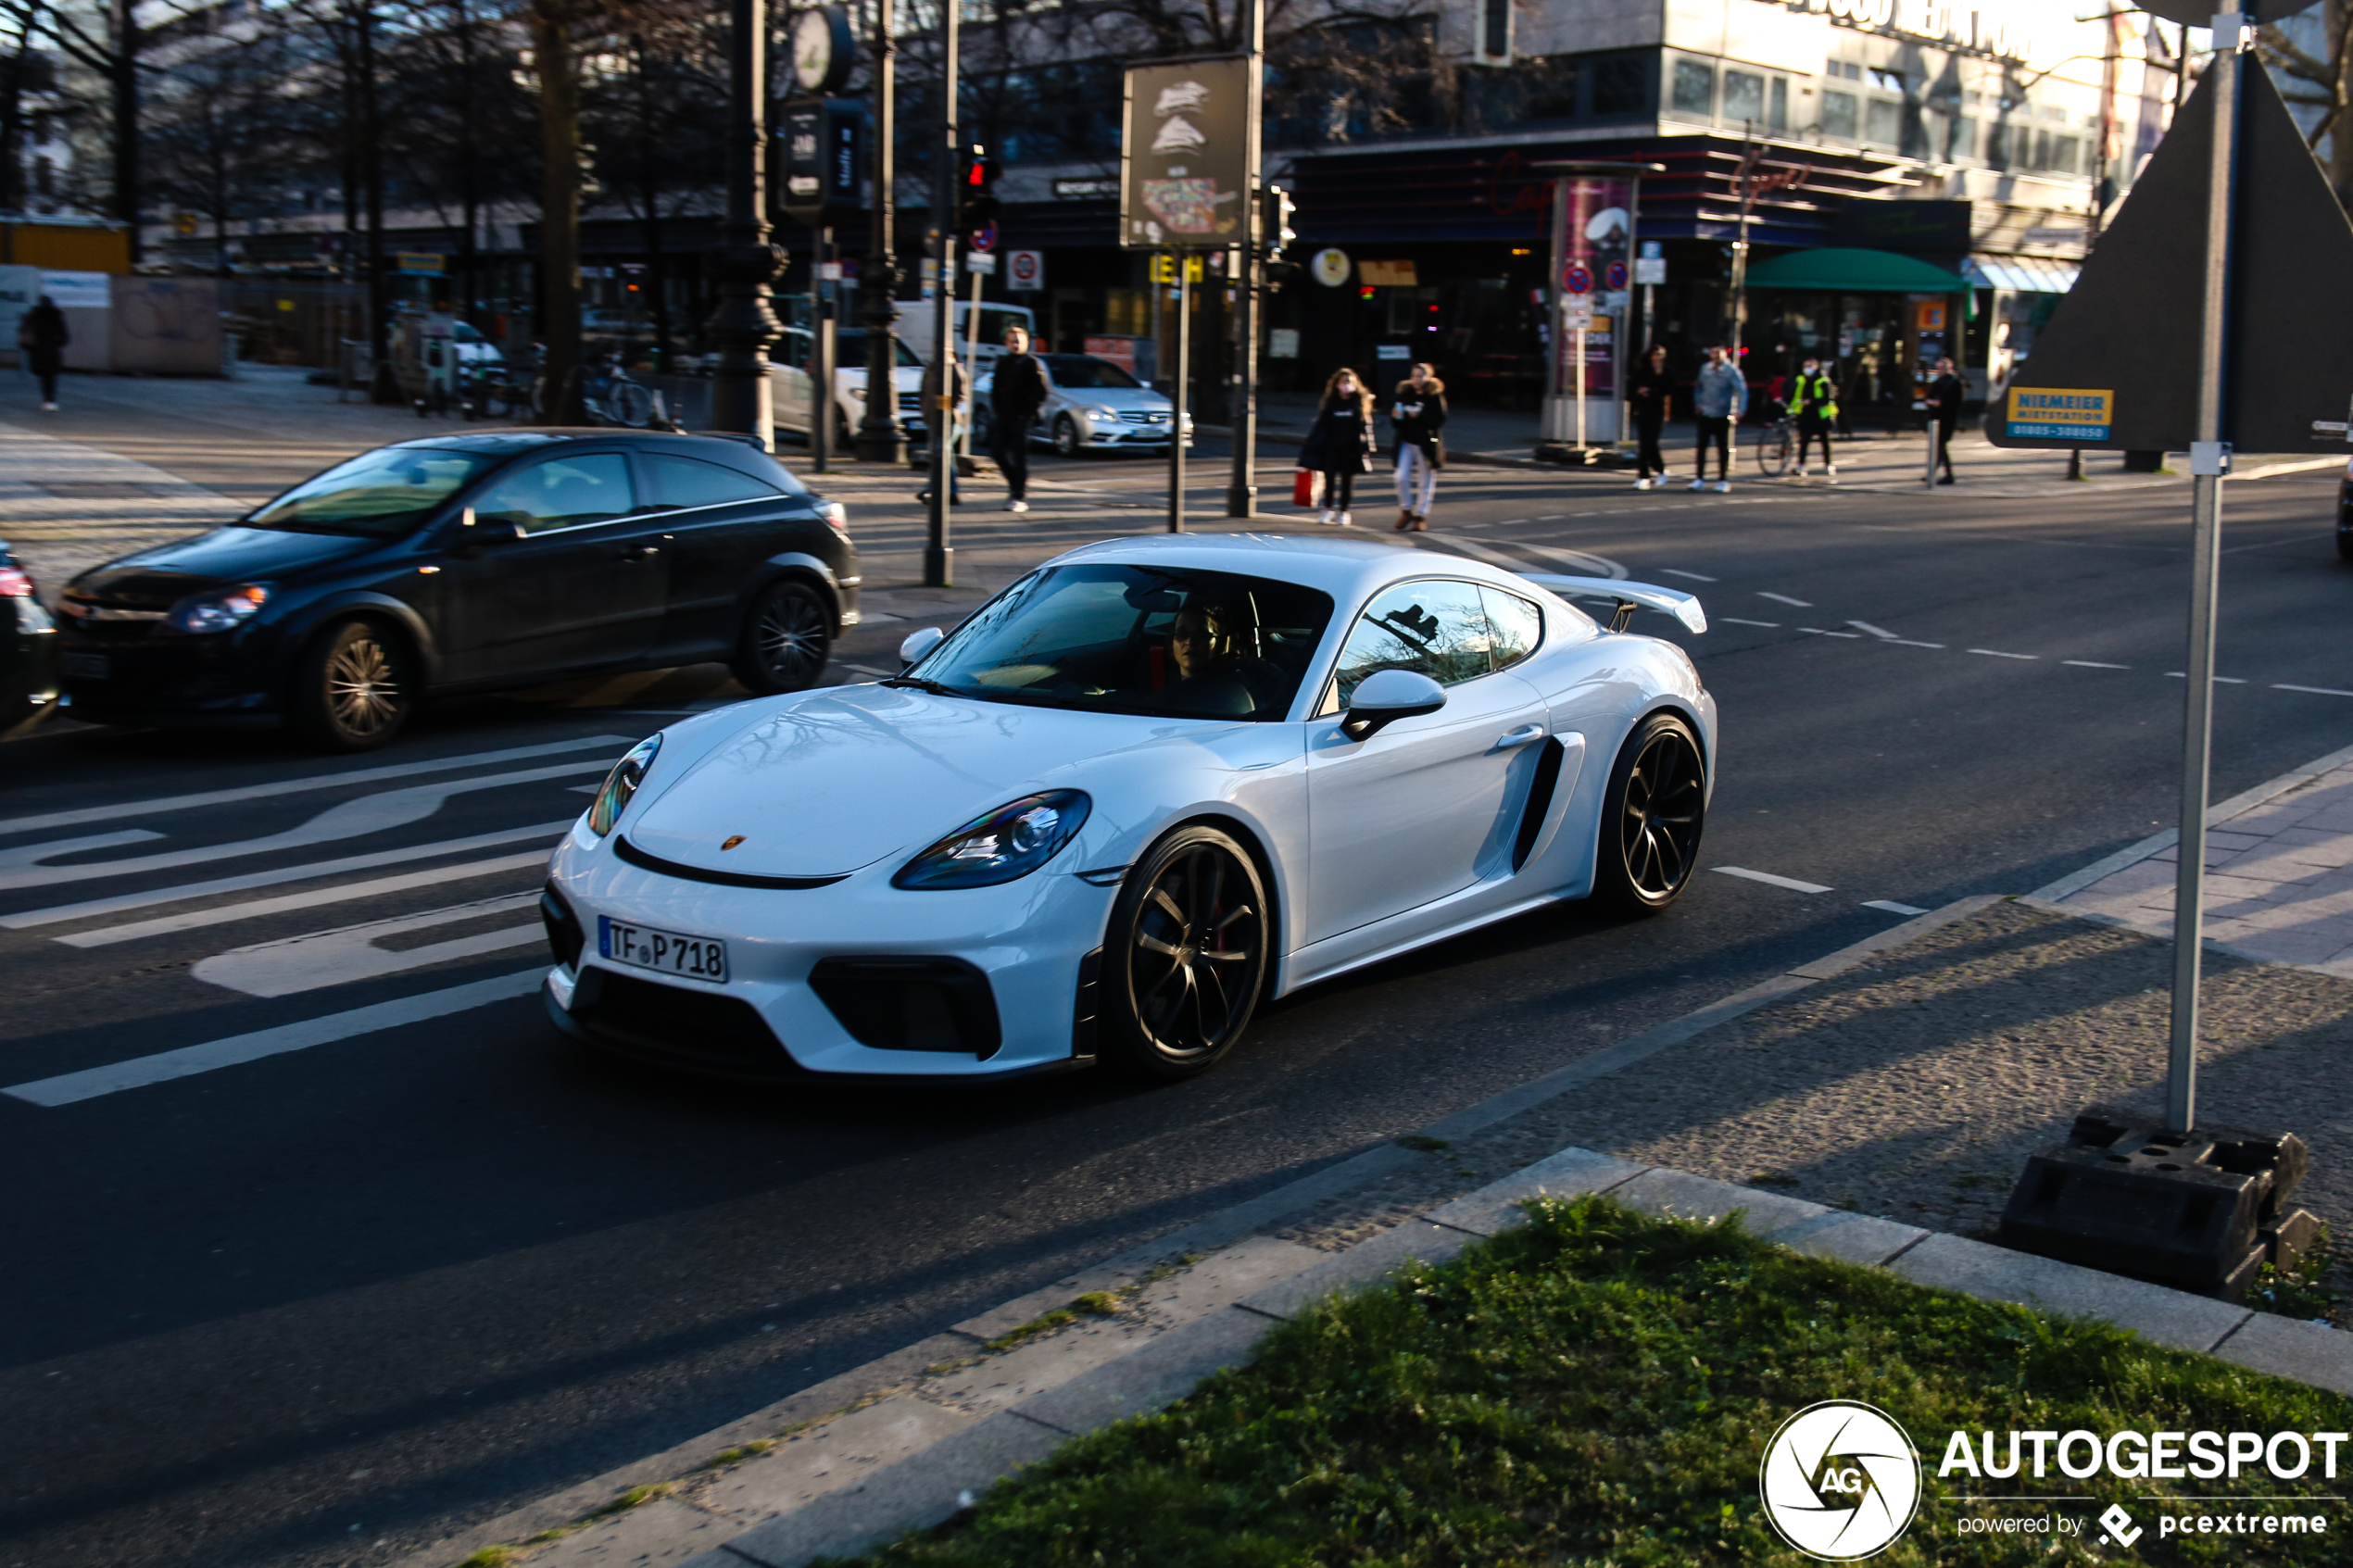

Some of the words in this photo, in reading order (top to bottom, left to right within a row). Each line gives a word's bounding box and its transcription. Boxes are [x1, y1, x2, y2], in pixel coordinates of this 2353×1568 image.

[2018, 394, 2105, 410] NIEMEIER
[2017, 410, 2104, 421] MIETSTATION
[610, 923, 637, 958] TF
[652, 934, 667, 965] P
[673, 937, 723, 976] 718
